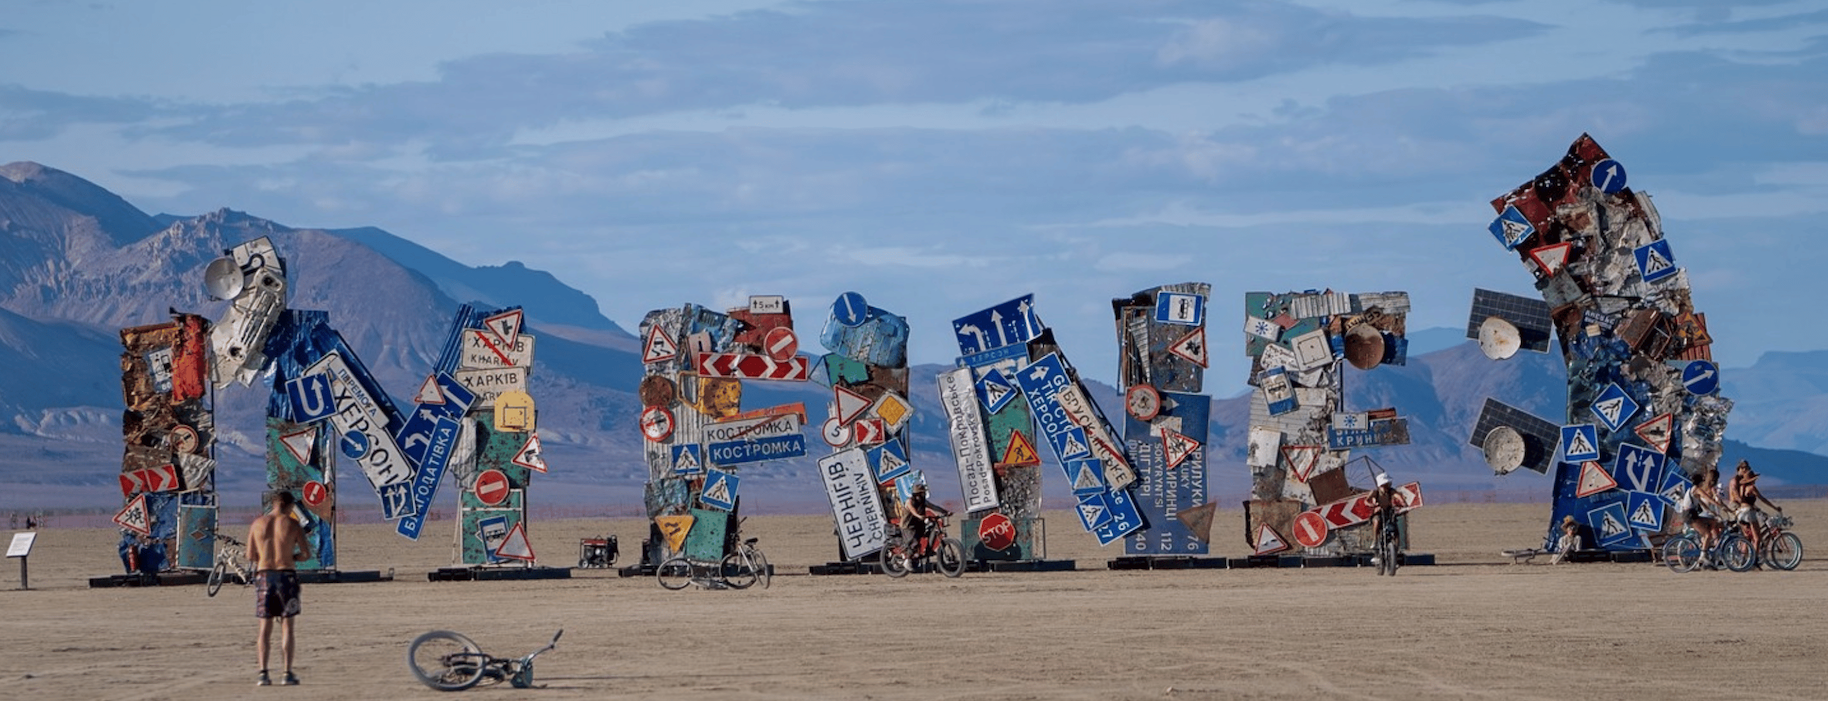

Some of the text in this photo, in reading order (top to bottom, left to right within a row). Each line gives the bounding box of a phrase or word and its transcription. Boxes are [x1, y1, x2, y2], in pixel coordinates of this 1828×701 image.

[758, 301, 764, 309] 5
[463, 372, 518, 388] ХАРКІВ
[707, 419, 794, 441] КОСТРОМКА
[831, 425, 842, 437] 5
[1336, 433, 1383, 447] КРИНИ
[713, 440, 802, 461] КОСТРОМКА
[1154, 442, 1164, 508] SOKYRYNTSI
[828, 461, 865, 549] ЧЕРНІГІВ
[1164, 470, 1178, 521] ИРИНЦІ
[853, 472, 884, 542] CHERNIHIV
[981, 520, 1011, 543] STOP
[1113, 512, 1130, 531] 26
[1160, 531, 1173, 551] 112
[1187, 534, 1199, 550] 76
